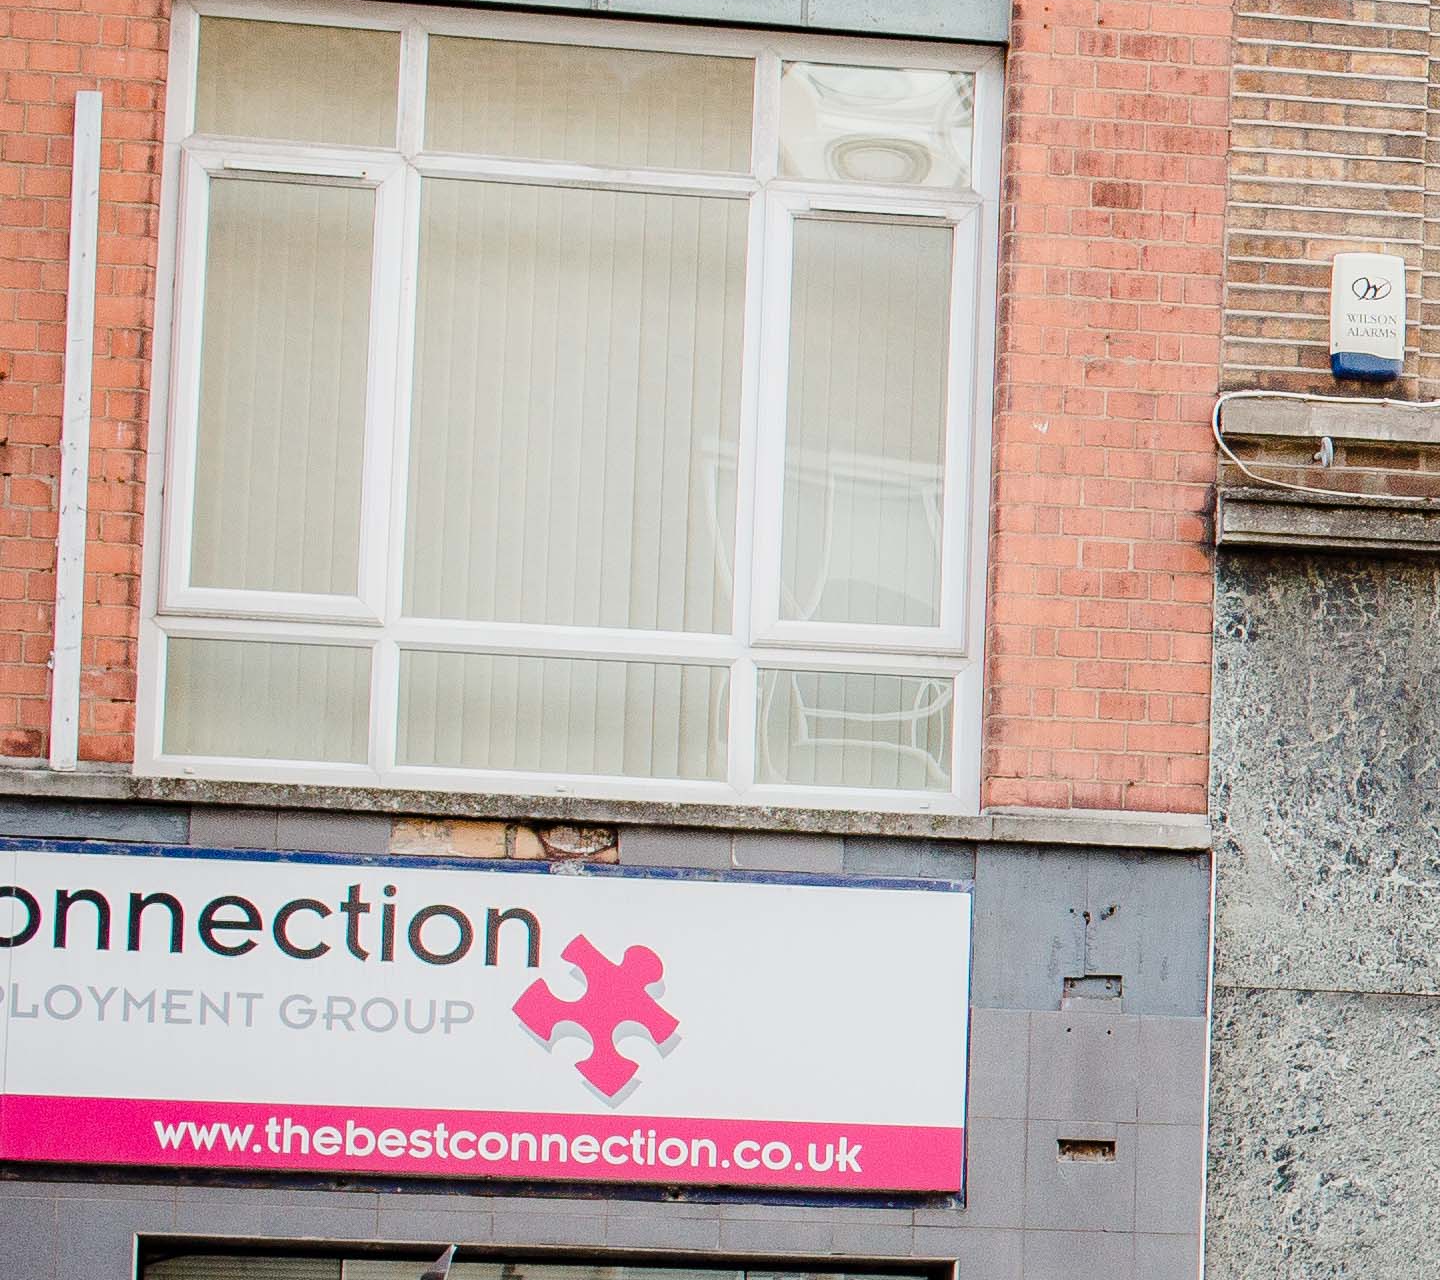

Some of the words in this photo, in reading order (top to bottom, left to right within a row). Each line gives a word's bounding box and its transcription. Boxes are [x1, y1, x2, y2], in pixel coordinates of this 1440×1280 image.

[1347, 313, 1397, 324] WILSON
[1347, 327, 1397, 338] ALARMS
[0, 983, 264, 1027] LOYMENT
[279, 993, 475, 1035] GROUP
[154, 1117, 863, 1173] www.thebestconnection.co.uk
